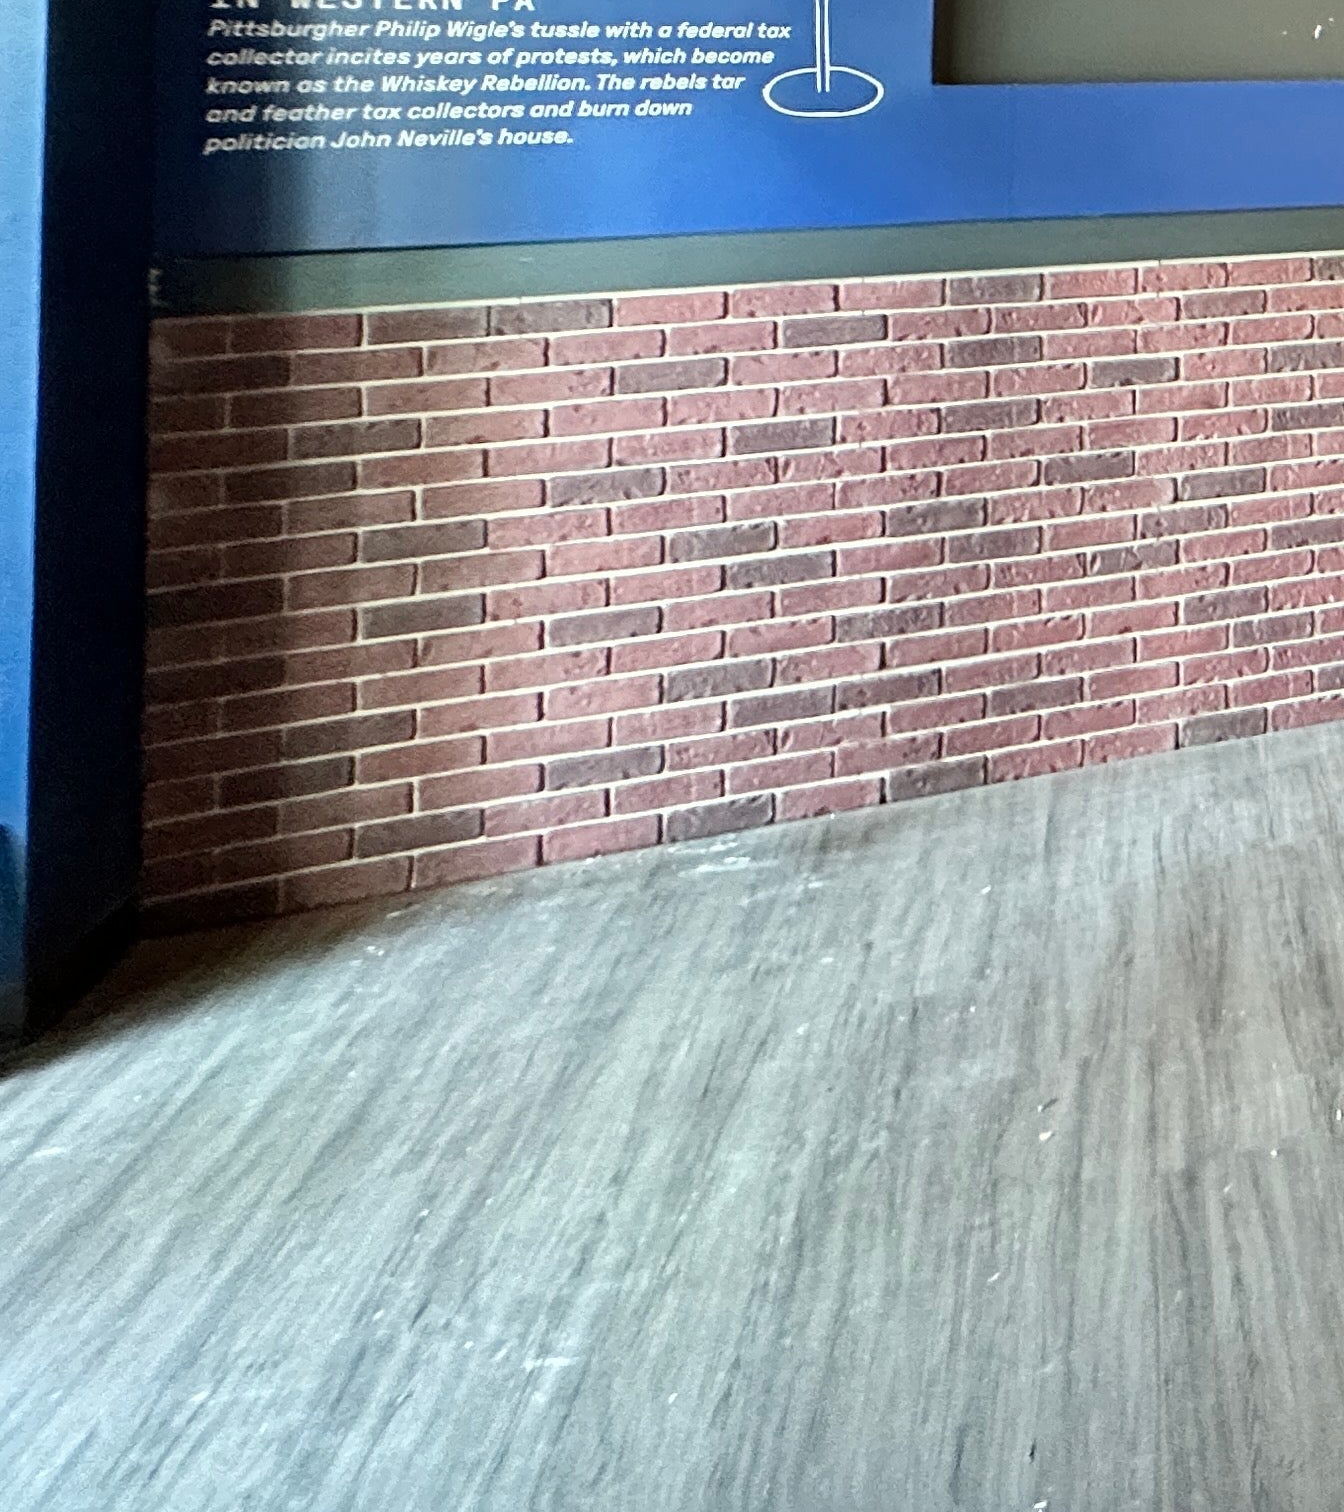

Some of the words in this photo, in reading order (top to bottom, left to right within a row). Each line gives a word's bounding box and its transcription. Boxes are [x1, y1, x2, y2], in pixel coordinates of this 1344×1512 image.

[208, 19, 371, 42] Pittsburgher
[373, 20, 441, 41] Philip
[446, 20, 525, 42] Wigle's
[530, 20, 601, 38] tussle
[605, 21, 653, 39] with
[657, 25, 673, 38] a
[676, 21, 754, 38] federal
[757, 22, 792, 39] tax
